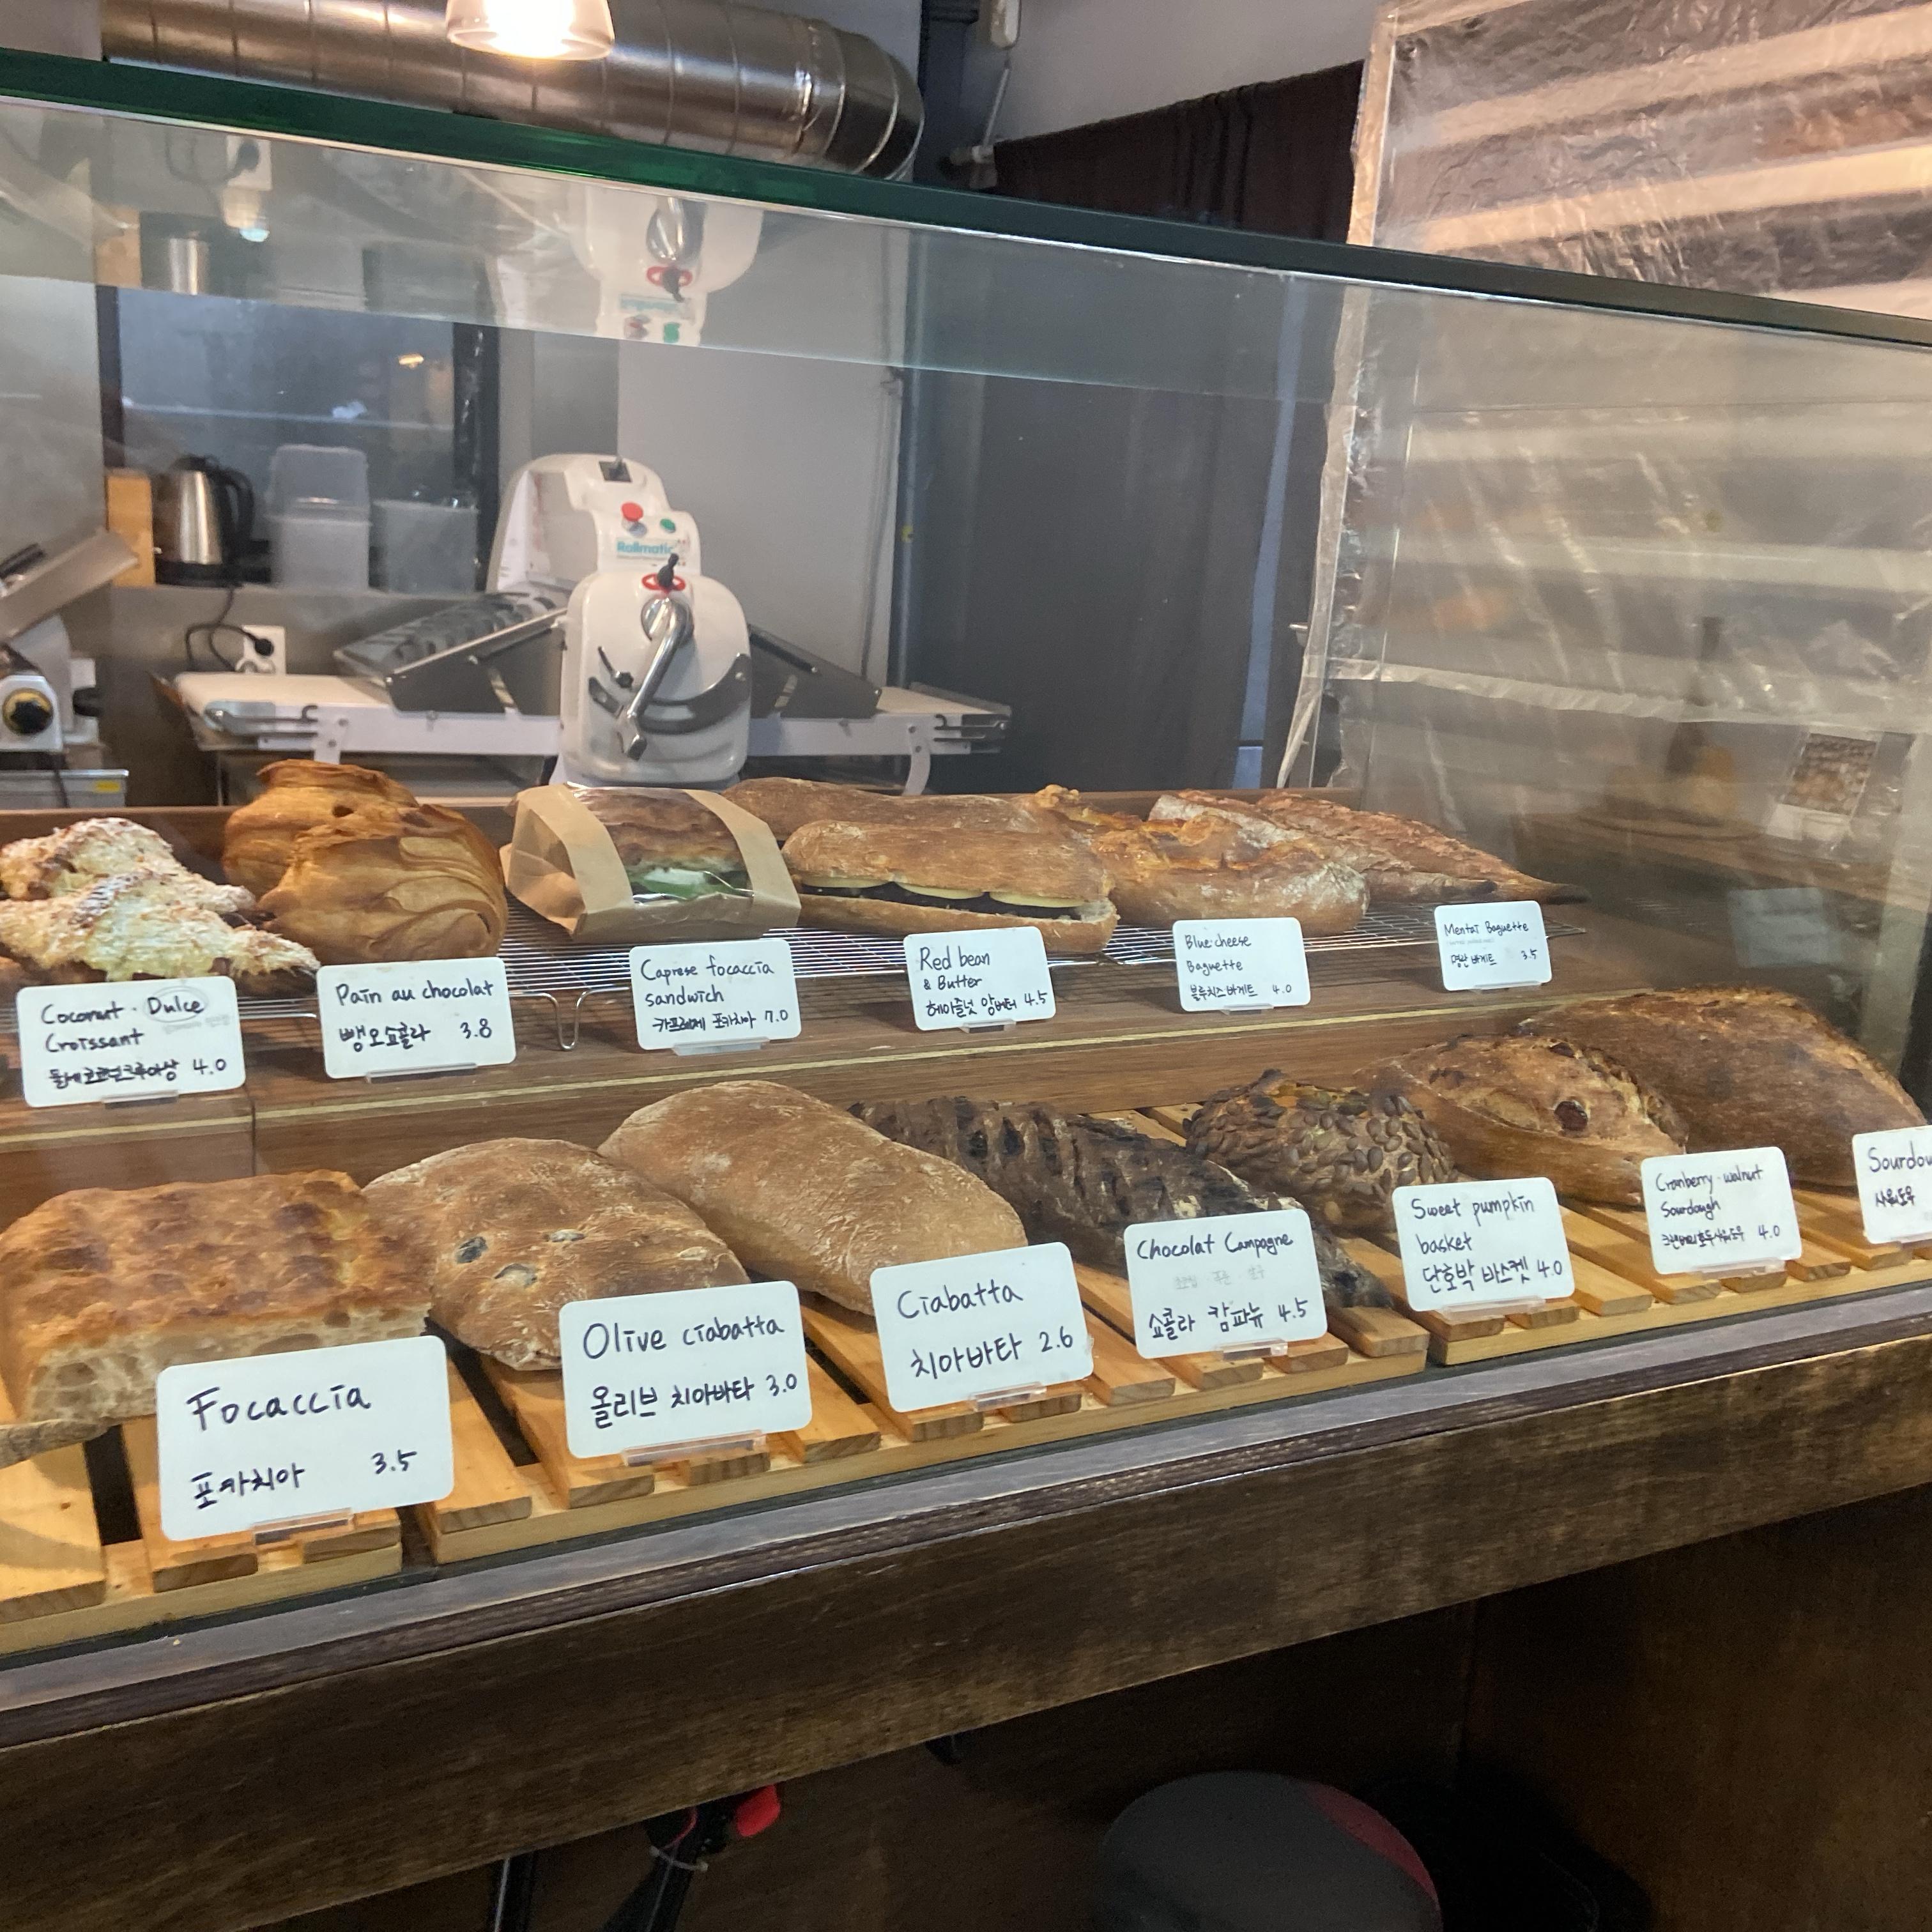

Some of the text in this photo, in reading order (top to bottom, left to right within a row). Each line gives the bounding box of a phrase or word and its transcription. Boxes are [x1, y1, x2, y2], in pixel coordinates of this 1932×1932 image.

[1485, 921, 1529, 937] Baguette
[640, 954, 774, 987] Caprese focaccia
[917, 946, 990, 971] Red bean
[1186, 960, 1243, 976] Baguette
[1451, 953, 1469, 968] 명란
[1471, 954, 1498, 965] 바게트
[335, 977, 494, 1006] Pain au chocolat
[645, 983, 724, 1007] sandwich
[924, 974, 983, 990] & Butter
[1273, 985, 1292, 994] 4.0
[147, 995, 204, 1017] Dulce
[765, 1009, 788, 1023] 7.0
[981, 993, 1017, 1016] 앙버터
[1024, 990, 1048, 1006] 4.5
[45, 1027, 145, 1053] Croissant
[460, 1018, 492, 1039] 3.8
[192, 1059, 227, 1075] 4.0
[1656, 1171, 1713, 1197] Cranberry
[1411, 1192, 1535, 1227] Sweet pumpkin
[1415, 1232, 1472, 1255] basket
[1758, 1224, 1780, 1240] 4.0
[1137, 1234, 1215, 1260] Chocolat
[1422, 1259, 1475, 1293] 단호박
[897, 1279, 1023, 1319] Ciabatta
[1149, 1308, 1196, 1340] 쇼콜라
[1278, 1297, 1308, 1322] 4.5
[583, 1315, 785, 1359] Olive ciabatta
[910, 1326, 1073, 1379] 치아바타 2.6
[186, 1384, 372, 1432] Focaccia
[590, 1374, 797, 1429] 올리브 치아바타 3.0
[190, 1449, 417, 1510] 포카치아 3.5
